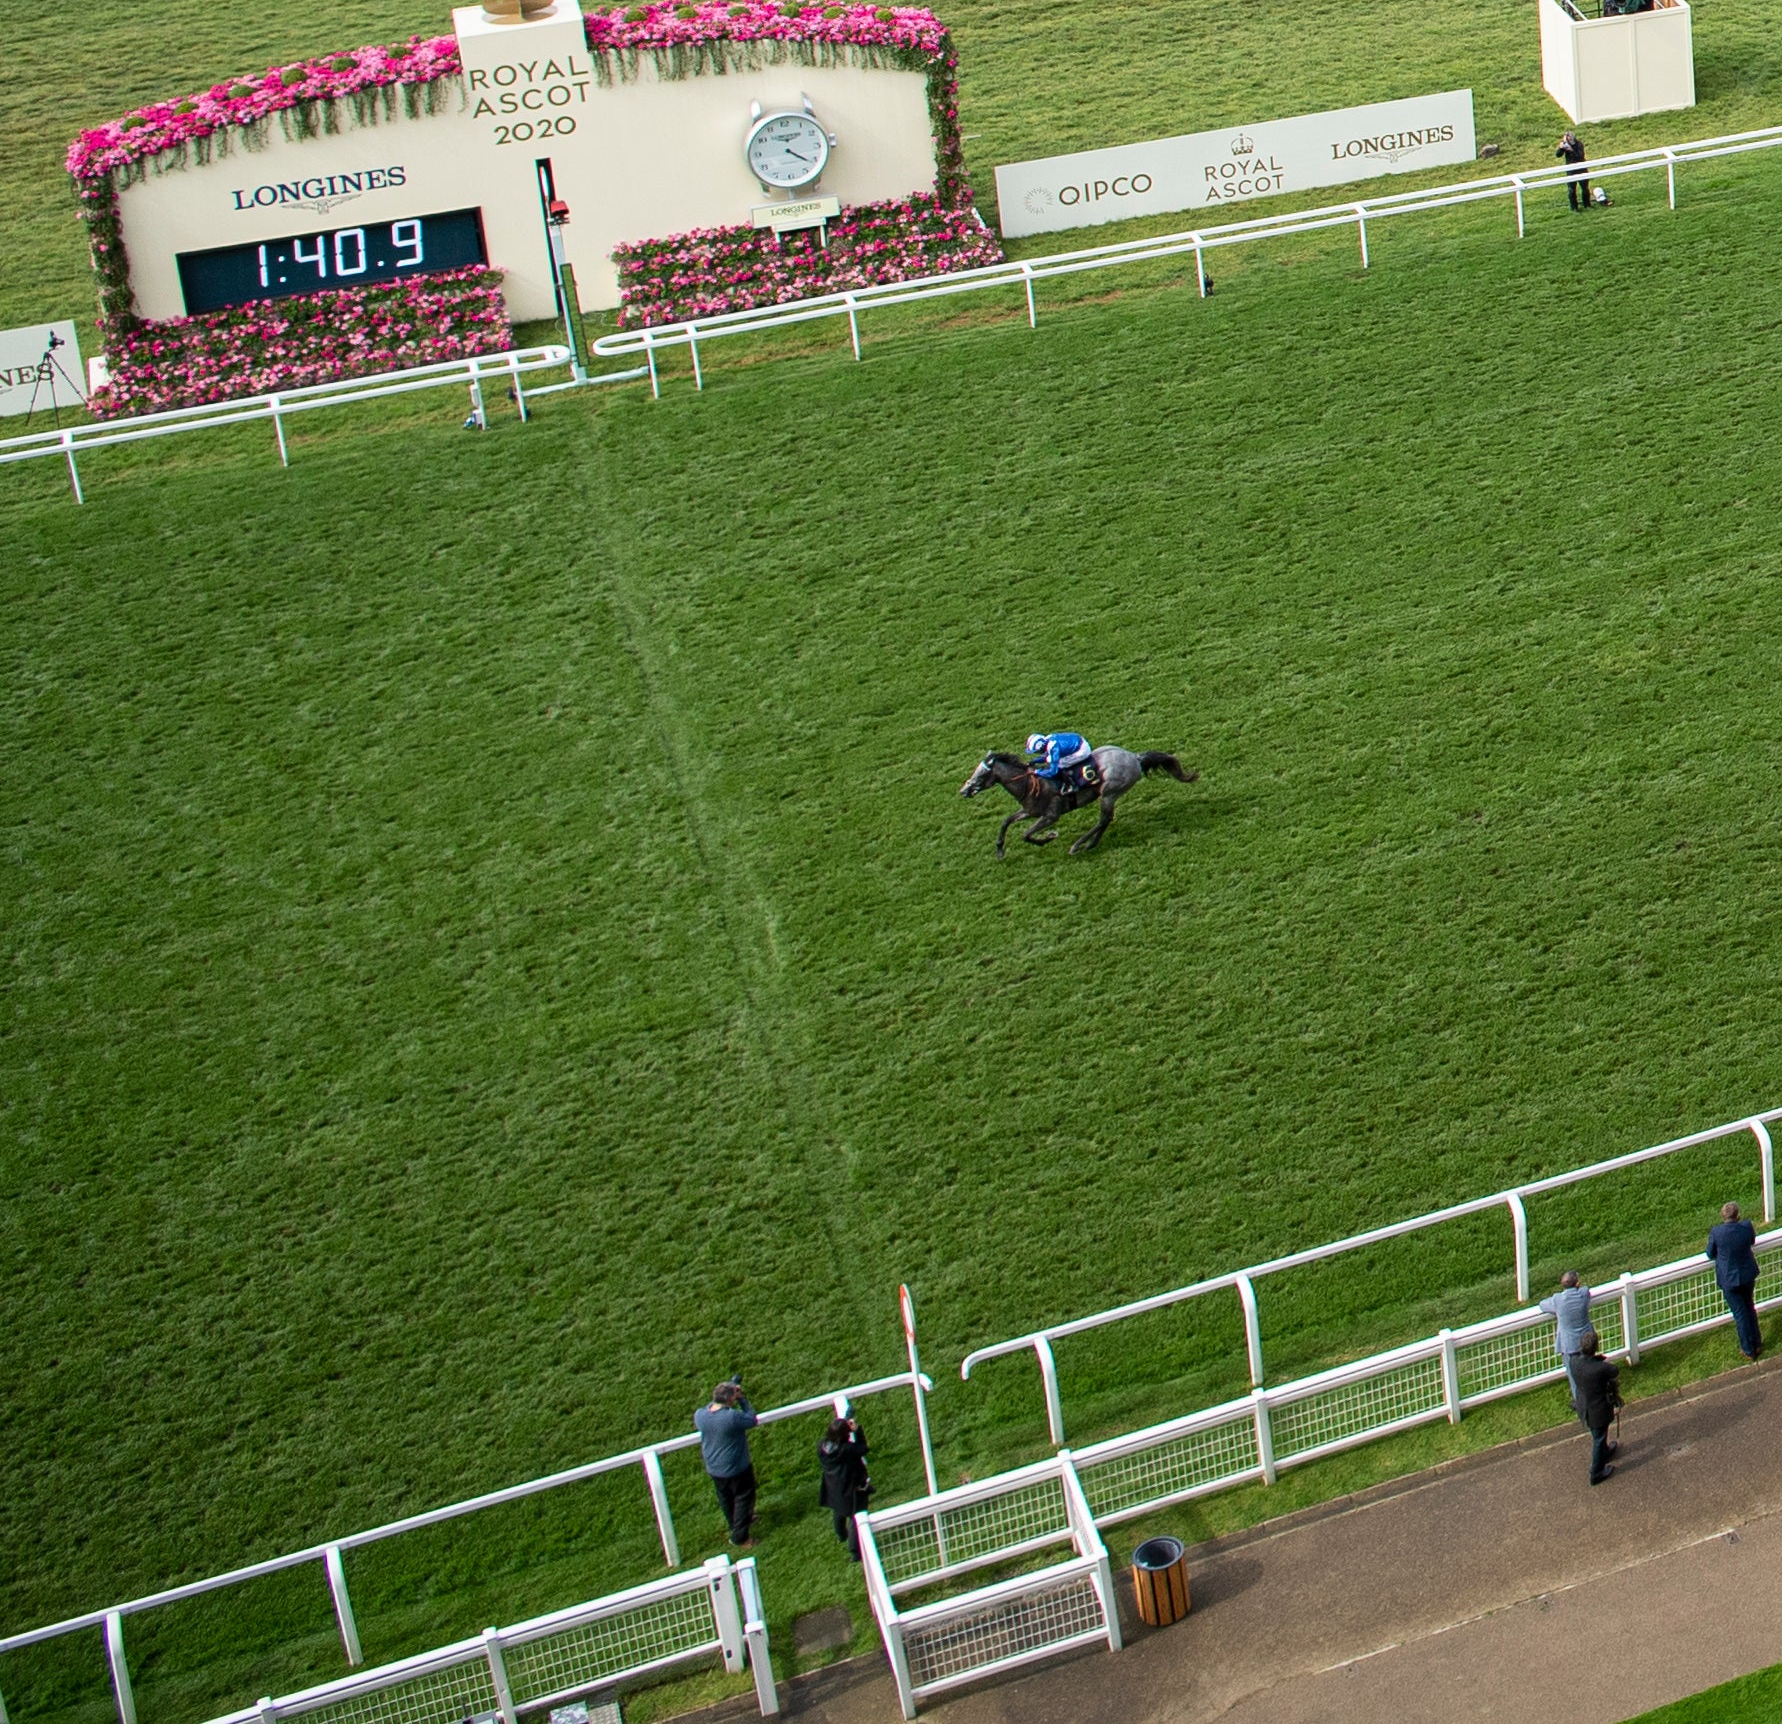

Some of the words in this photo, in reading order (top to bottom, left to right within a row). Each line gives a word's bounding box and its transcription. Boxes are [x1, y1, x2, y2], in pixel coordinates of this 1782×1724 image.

[469, 56, 589, 91] ROYAL
[473, 81, 590, 119] ASCOT
[494, 116, 577, 145] 2020
[1331, 124, 1454, 160] LONGINES
[1203, 154, 1284, 181] ROYAL
[232, 165, 407, 210] LONGINES
[1058, 172, 1152, 208] QIPCO
[1205, 172, 1285, 203] ASCOT
[771, 202, 822, 217] LONGINES
[1082, 765, 1096, 781] 6
